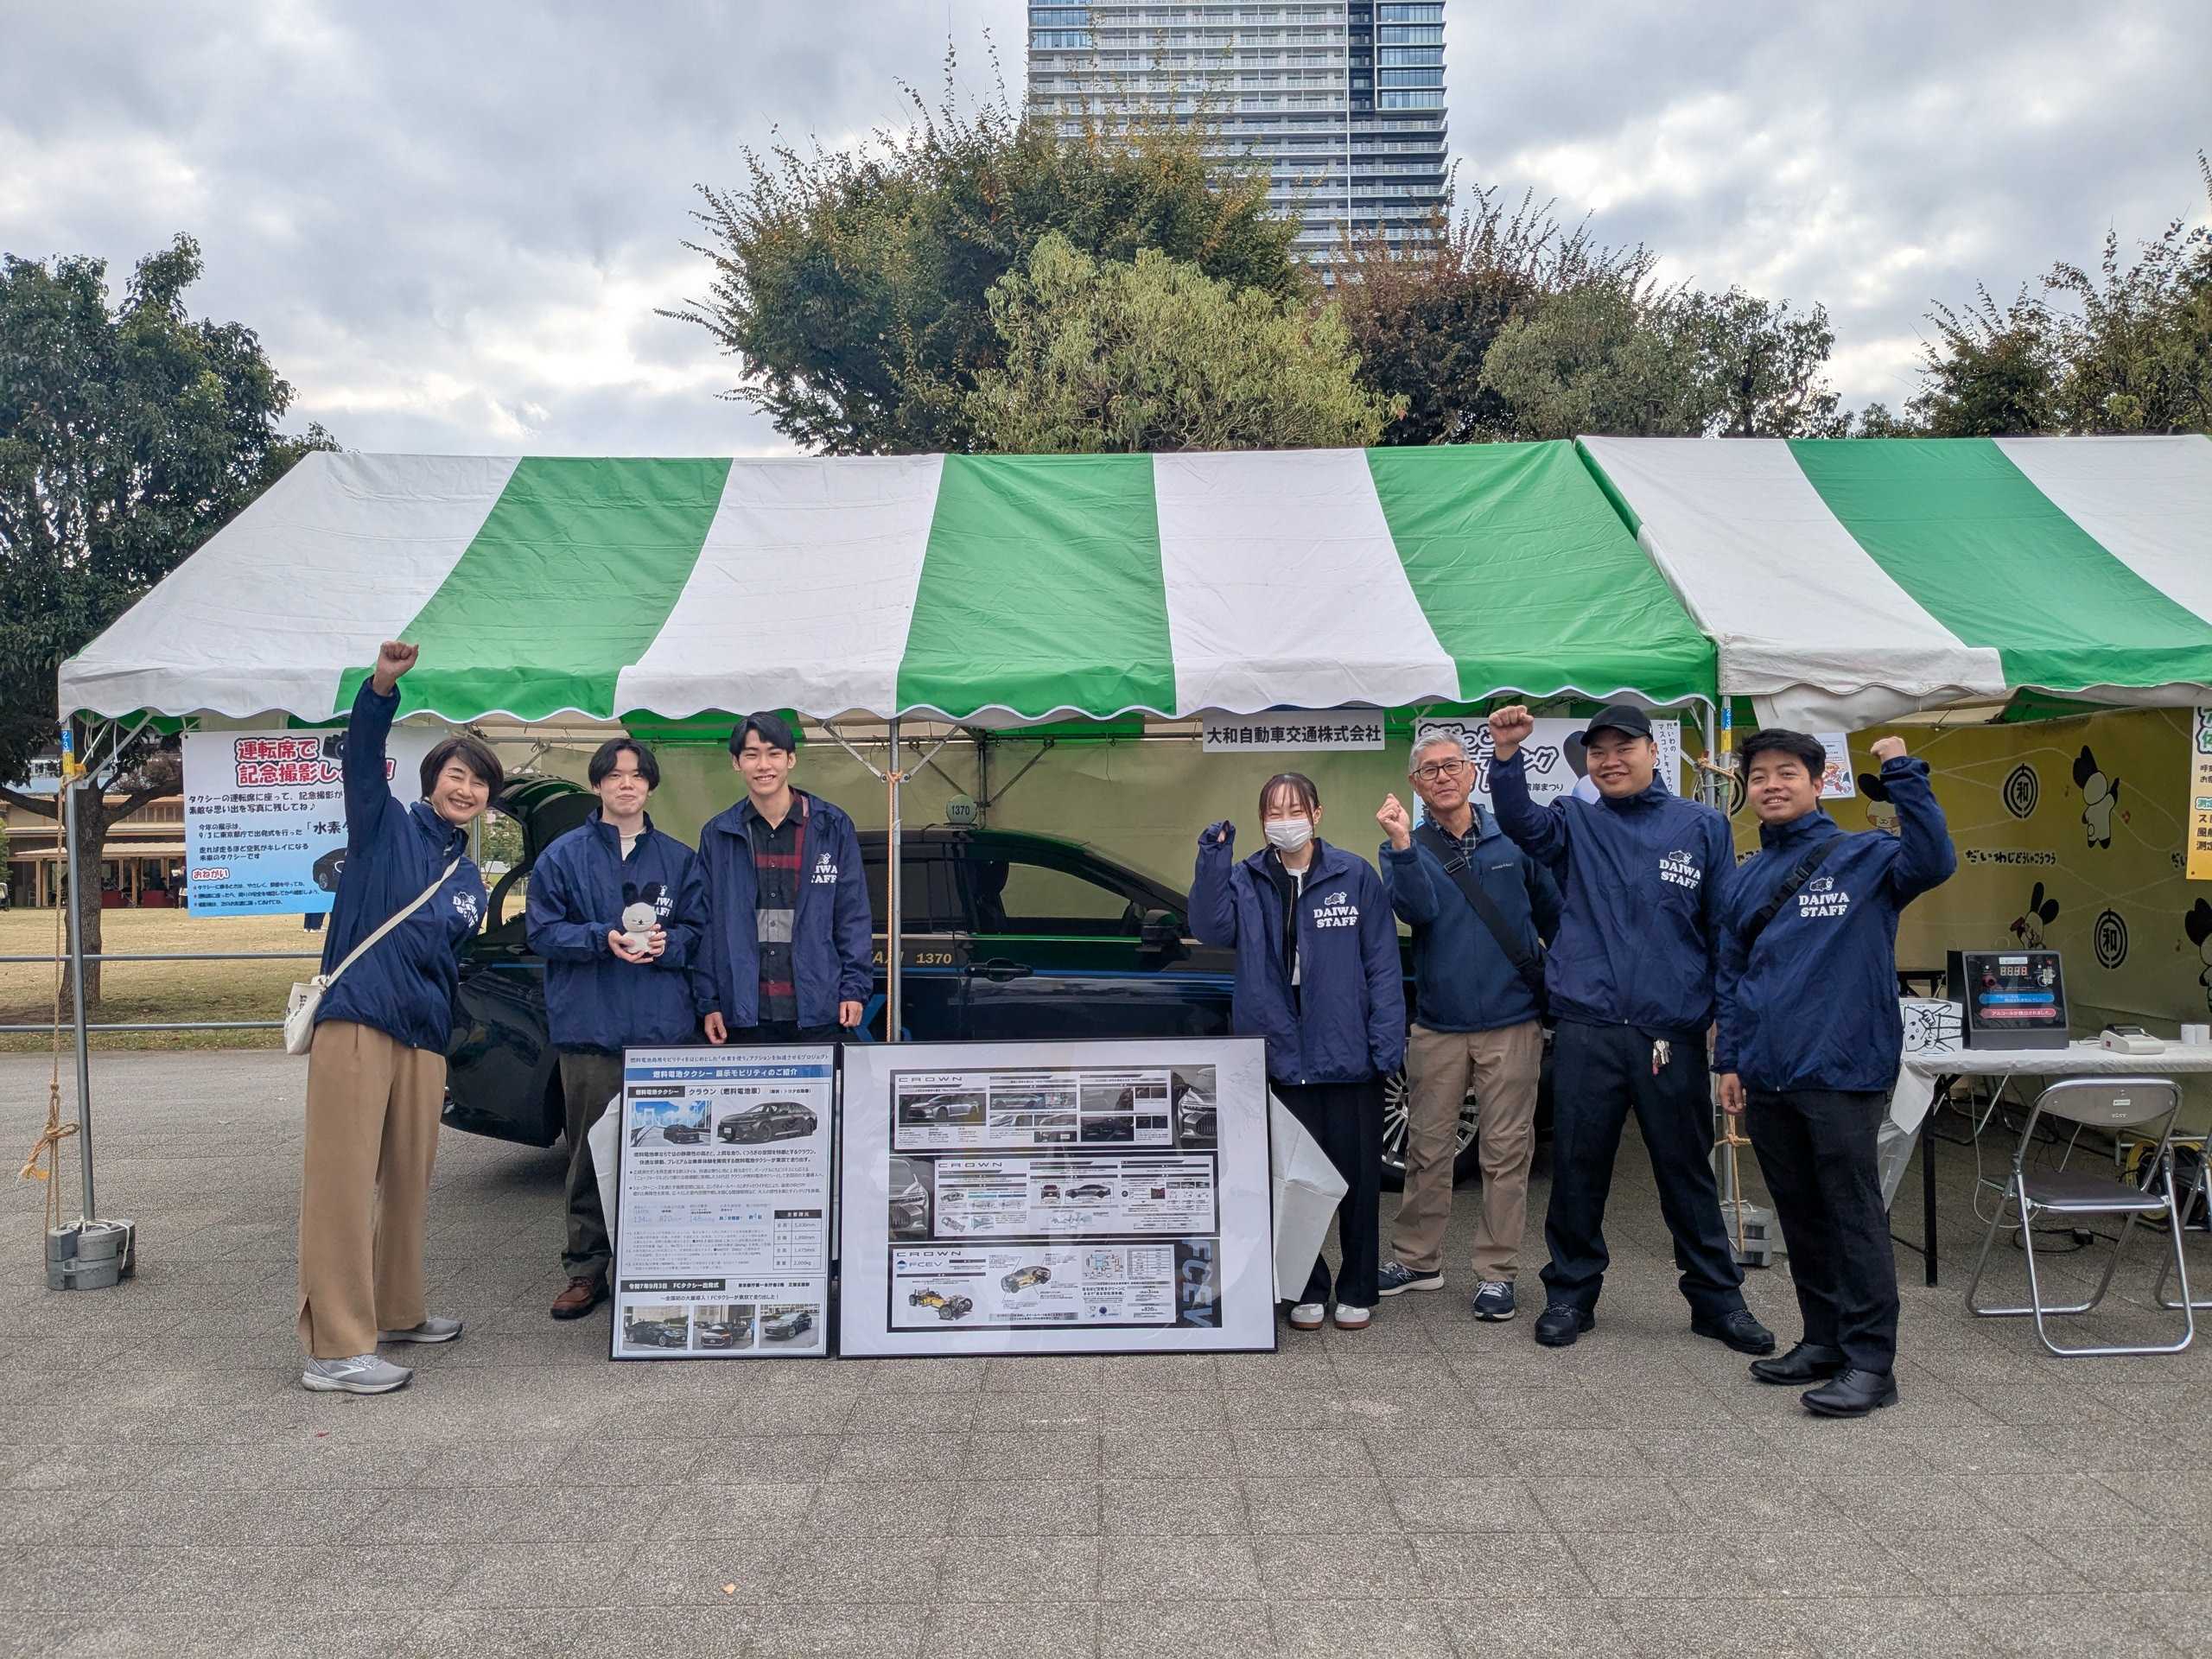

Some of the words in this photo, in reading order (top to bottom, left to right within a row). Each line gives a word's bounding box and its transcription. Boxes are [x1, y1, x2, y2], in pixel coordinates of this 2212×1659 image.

[1206, 724, 1382, 744] 大和自動車交通株式会社
[236, 739, 318, 761] 運転席で
[2016, 780, 2029, 804] 和
[951, 804, 970, 816] 1370
[193, 868, 230, 880] おねがい
[1658, 858, 1701, 880] DAIWA
[1660, 871, 1699, 890] STAFF
[1798, 892, 1850, 906] DAIWA
[1313, 906, 1359, 918] DAIWA
[1800, 905, 1848, 917] STAFF
[1316, 916, 1357, 928] STAFF
[2102, 926, 2118, 952] 和
[916, 952, 953, 964] 1370
[652, 1069, 713, 1078] 燃料電池タクシー
[715, 1068, 798, 1077] 展示モビリティのご紹介
